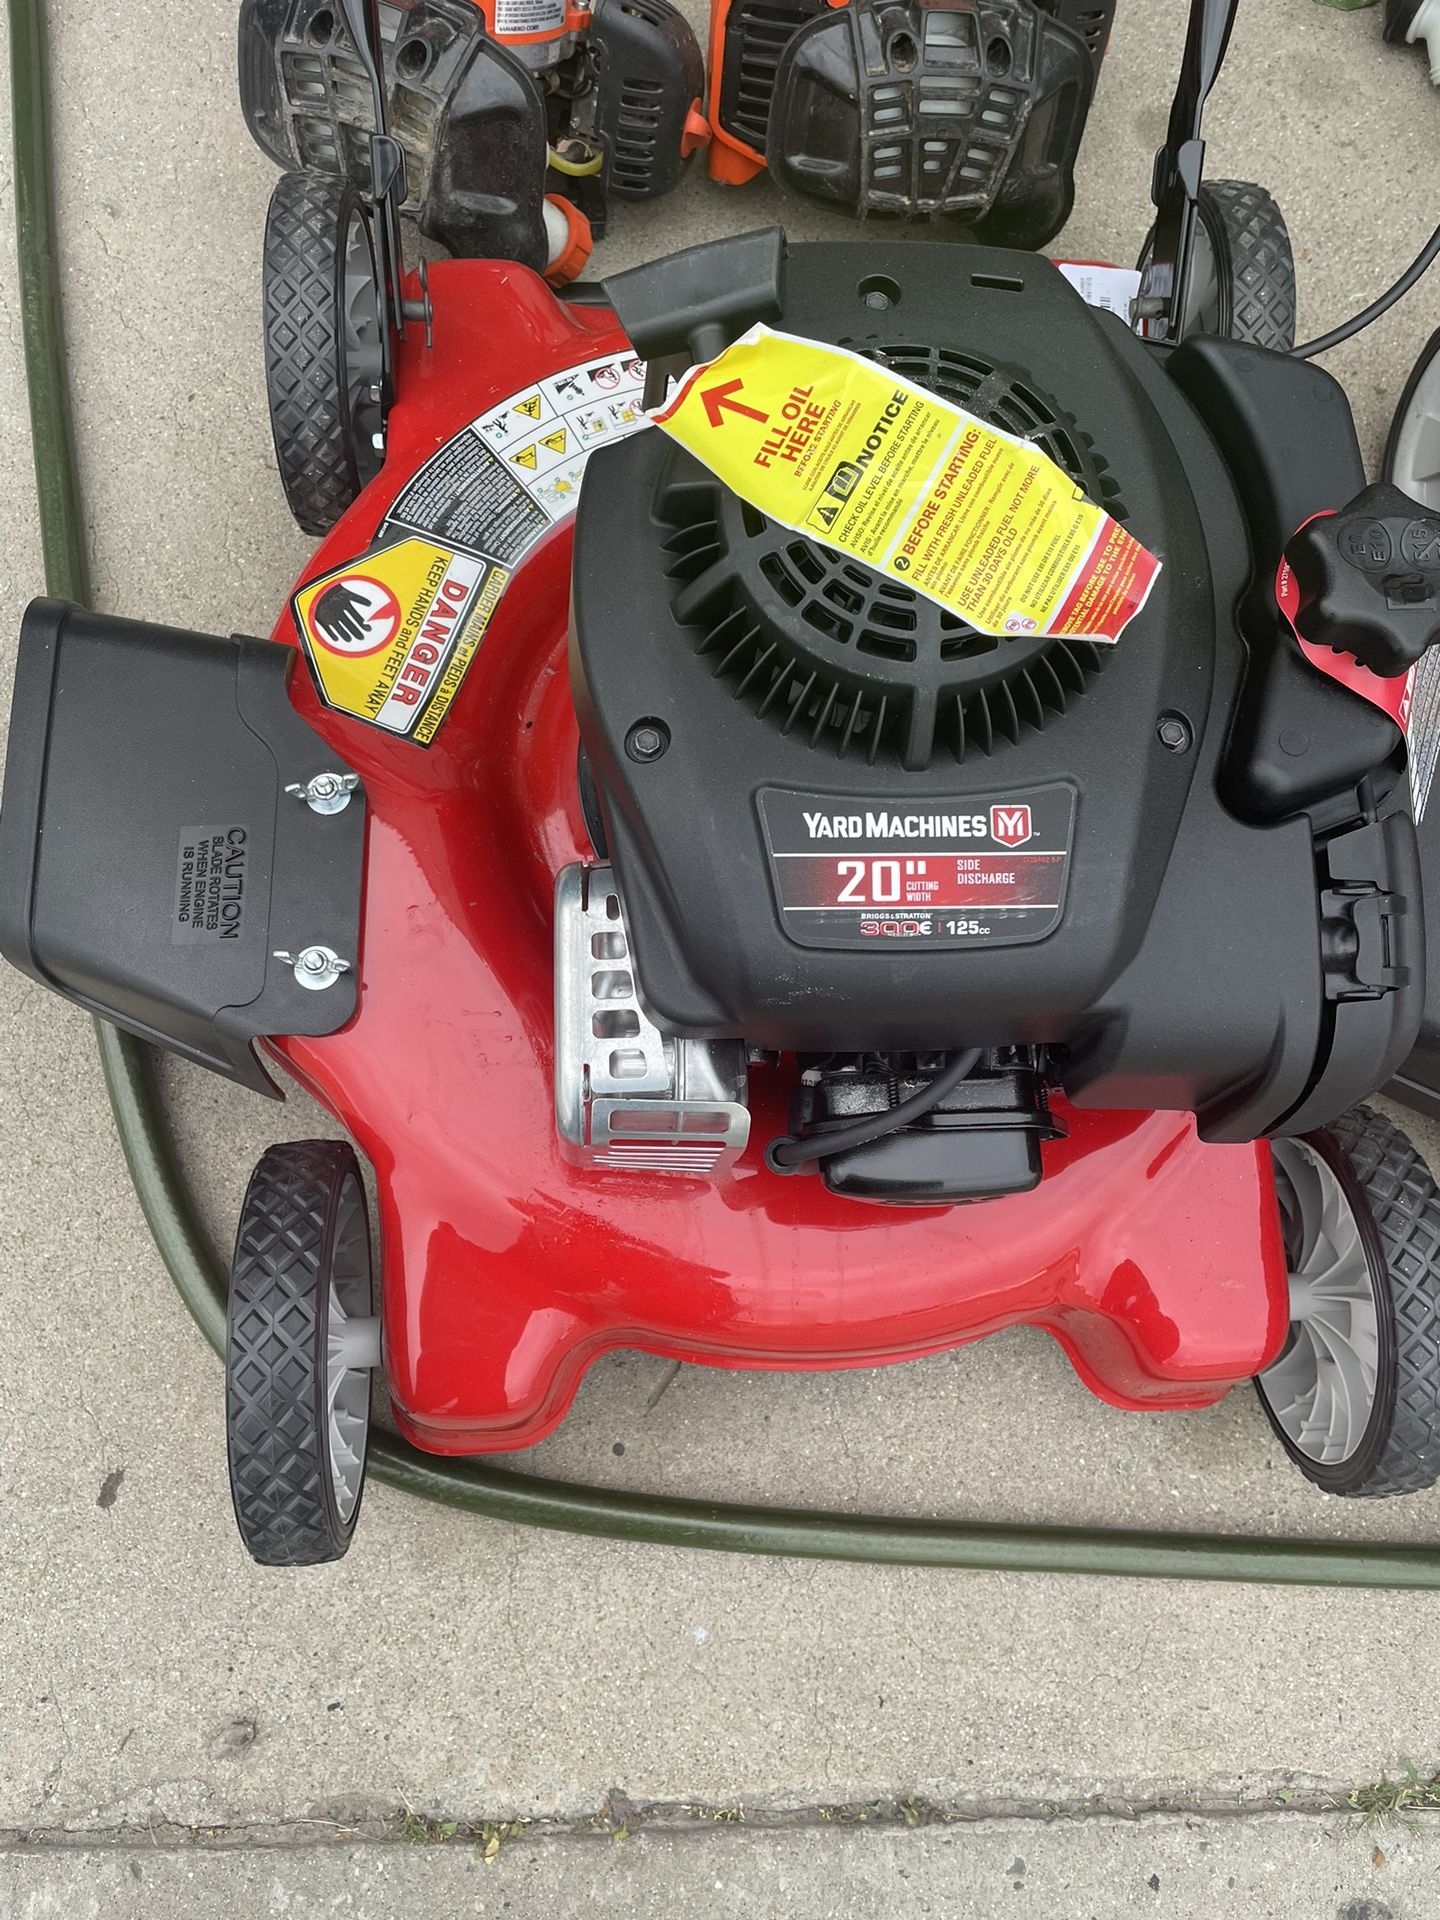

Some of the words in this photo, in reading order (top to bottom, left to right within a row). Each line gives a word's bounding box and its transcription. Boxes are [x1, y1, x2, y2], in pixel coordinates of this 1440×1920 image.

[754, 426, 792, 468] FILL
[782, 386, 814, 420] OIL
[781, 402, 826, 462] HERE
[794, 444, 818, 477] BEFORE
[814, 400, 841, 442] STARTING
[856, 390, 908, 468] NOTICE
[838, 513, 860, 543] CHECK
[855, 501, 868, 514] OIL
[862, 475, 883, 500] LEVEL
[878, 440, 901, 474] BEFORE
[897, 401, 924, 442] STARTING
[903, 501, 941, 555] BEFORE
[934, 429, 981, 500] STARTING:
[912, 564, 928, 581] FILL
[922, 537, 941, 561] WITH
[936, 508, 958, 538] FRESH
[952, 460, 984, 508] UNLEADED
[979, 439, 997, 460] FUEL
[957, 585, 974, 607] USE
[969, 536, 1001, 586] UNLEADED
[996, 514, 1014, 536] FUEL
[1009, 492, 1024, 513] NOT
[1019, 466, 1040, 494] MORE
[1370, 529, 1386, 562] E10
[426, 556, 448, 588] KEEP
[966, 584, 987, 612] THAN
[982, 572, 994, 585] 30
[988, 547, 1007, 573] DAYS
[1003, 528, 1018, 547] OLD
[1071, 602, 1084, 616] TAG
[1079, 574, 1099, 602] BEFORE
[1094, 558, 1107, 574] USE
[1103, 545, 1113, 556] TO
[1085, 575, 1107, 607] DAMAGE
[1102, 563, 1113, 575] TO
[1109, 546, 1121, 562] THE
[406, 587, 434, 628] HANDS
[478, 570, 506, 614] GARDER
[392, 580, 469, 707] DANGER
[395, 628, 412, 650] and
[463, 613, 488, 648] MAINS
[382, 650, 405, 681] FEET
[444, 657, 467, 688] PIEDS
[458, 647, 468, 658] et
[364, 680, 390, 715] AWAY
[416, 693, 449, 743] DISTANCE
[184, 846, 194, 859] IS
[195, 840, 209, 878] WHEN
[210, 836, 224, 874] BLADE
[957, 860, 980, 871] SIDE
[178, 862, 194, 923] RUNNING
[220, 827, 246, 939] CAUTION
[837, 860, 926, 902] 20"
[906, 881, 939, 891] CUTTING
[906, 892, 931, 902] WIDTH
[957, 872, 1015, 885] DISCHARGE
[192, 880, 206, 929] ENGINE
[206, 876, 222, 930] ROTATES
[946, 921, 990, 934] 125cc
